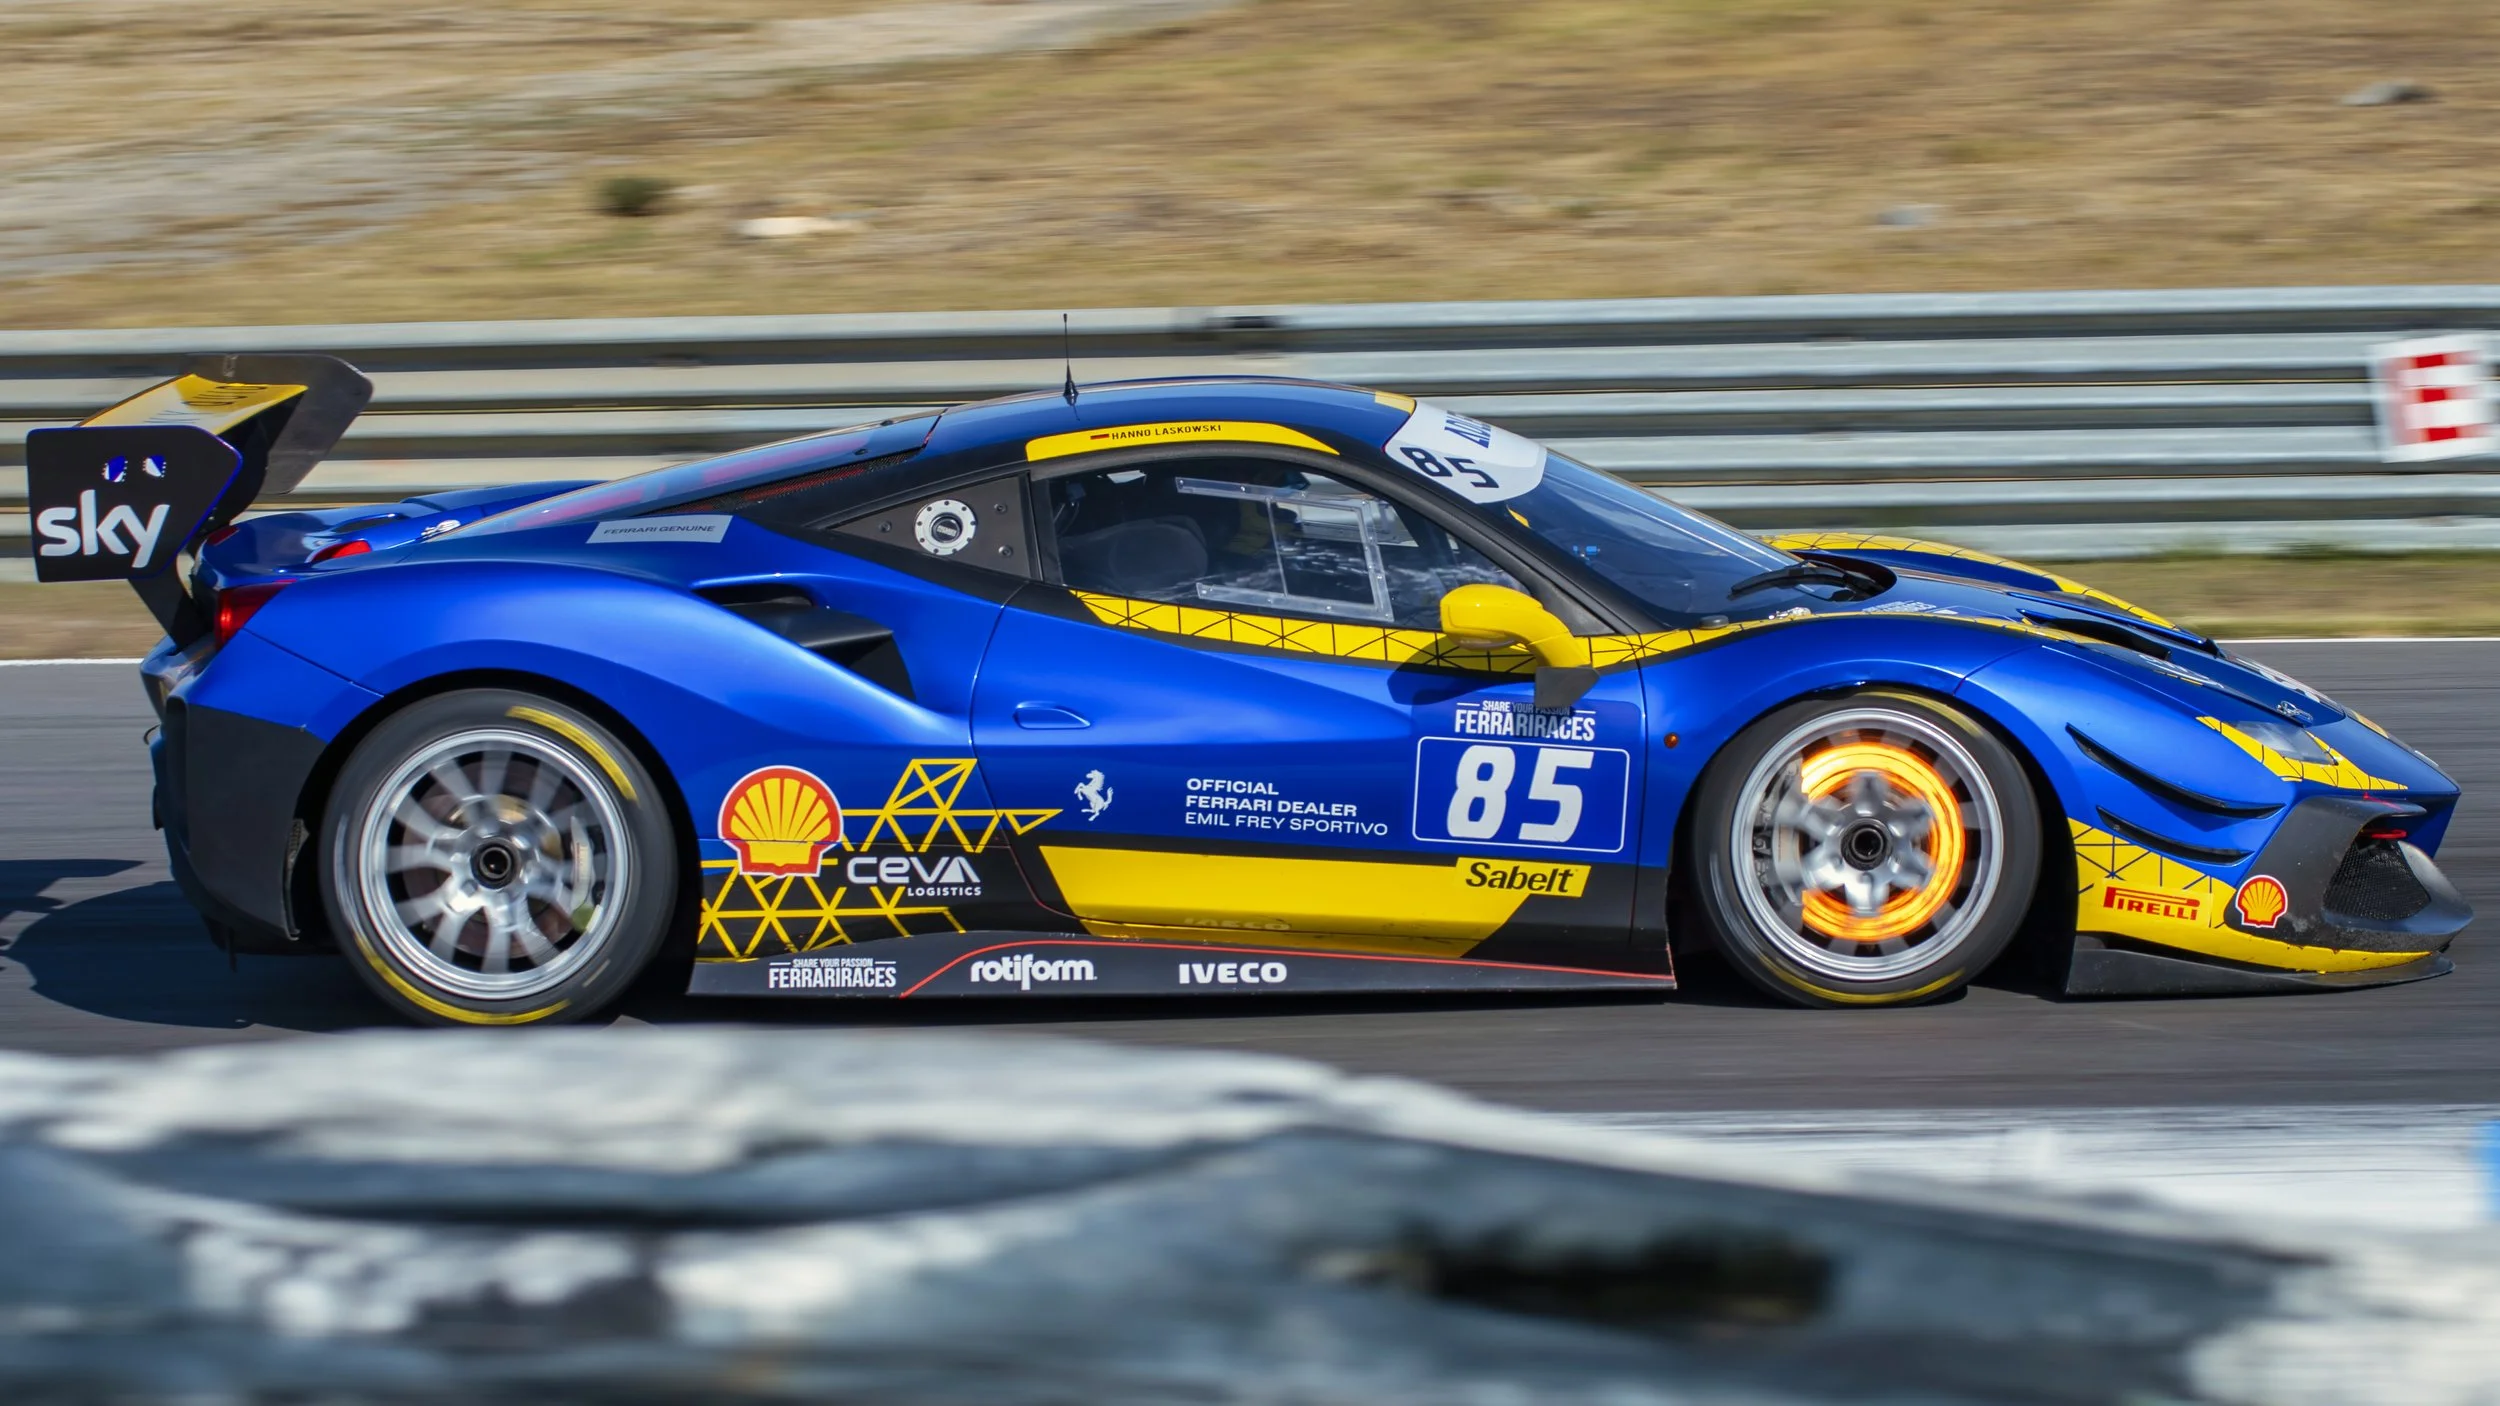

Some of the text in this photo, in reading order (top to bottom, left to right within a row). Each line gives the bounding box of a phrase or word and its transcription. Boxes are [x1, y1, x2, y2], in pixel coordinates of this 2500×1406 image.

[1112, 425, 1222, 440] HANNO LASKOWSKI
[1400, 447, 1500, 489] 85
[36, 489, 170, 568] sky
[603, 525, 715, 535] FERRARI GENUINE
[1482, 700, 1511, 712] SHARE
[1511, 702, 1534, 714] YOUR
[1455, 709, 1596, 742] FERRARIRACES
[1186, 778, 1280, 796] OFFICIAL
[1446, 745, 1595, 843] 85
[1185, 795, 1358, 817] FERRARI DEALER
[1185, 812, 1389, 836] EMIL FREY SPORTIVO
[1465, 862, 1574, 893] Sabelt
[907, 887, 982, 897] LOGISTICS
[2103, 886, 2201, 921] PIRELLI
[792, 958, 874, 968] SHARE YOUR PASSION
[1179, 962, 1288, 984] IVECO
[769, 967, 897, 988] FERRARIRACES
